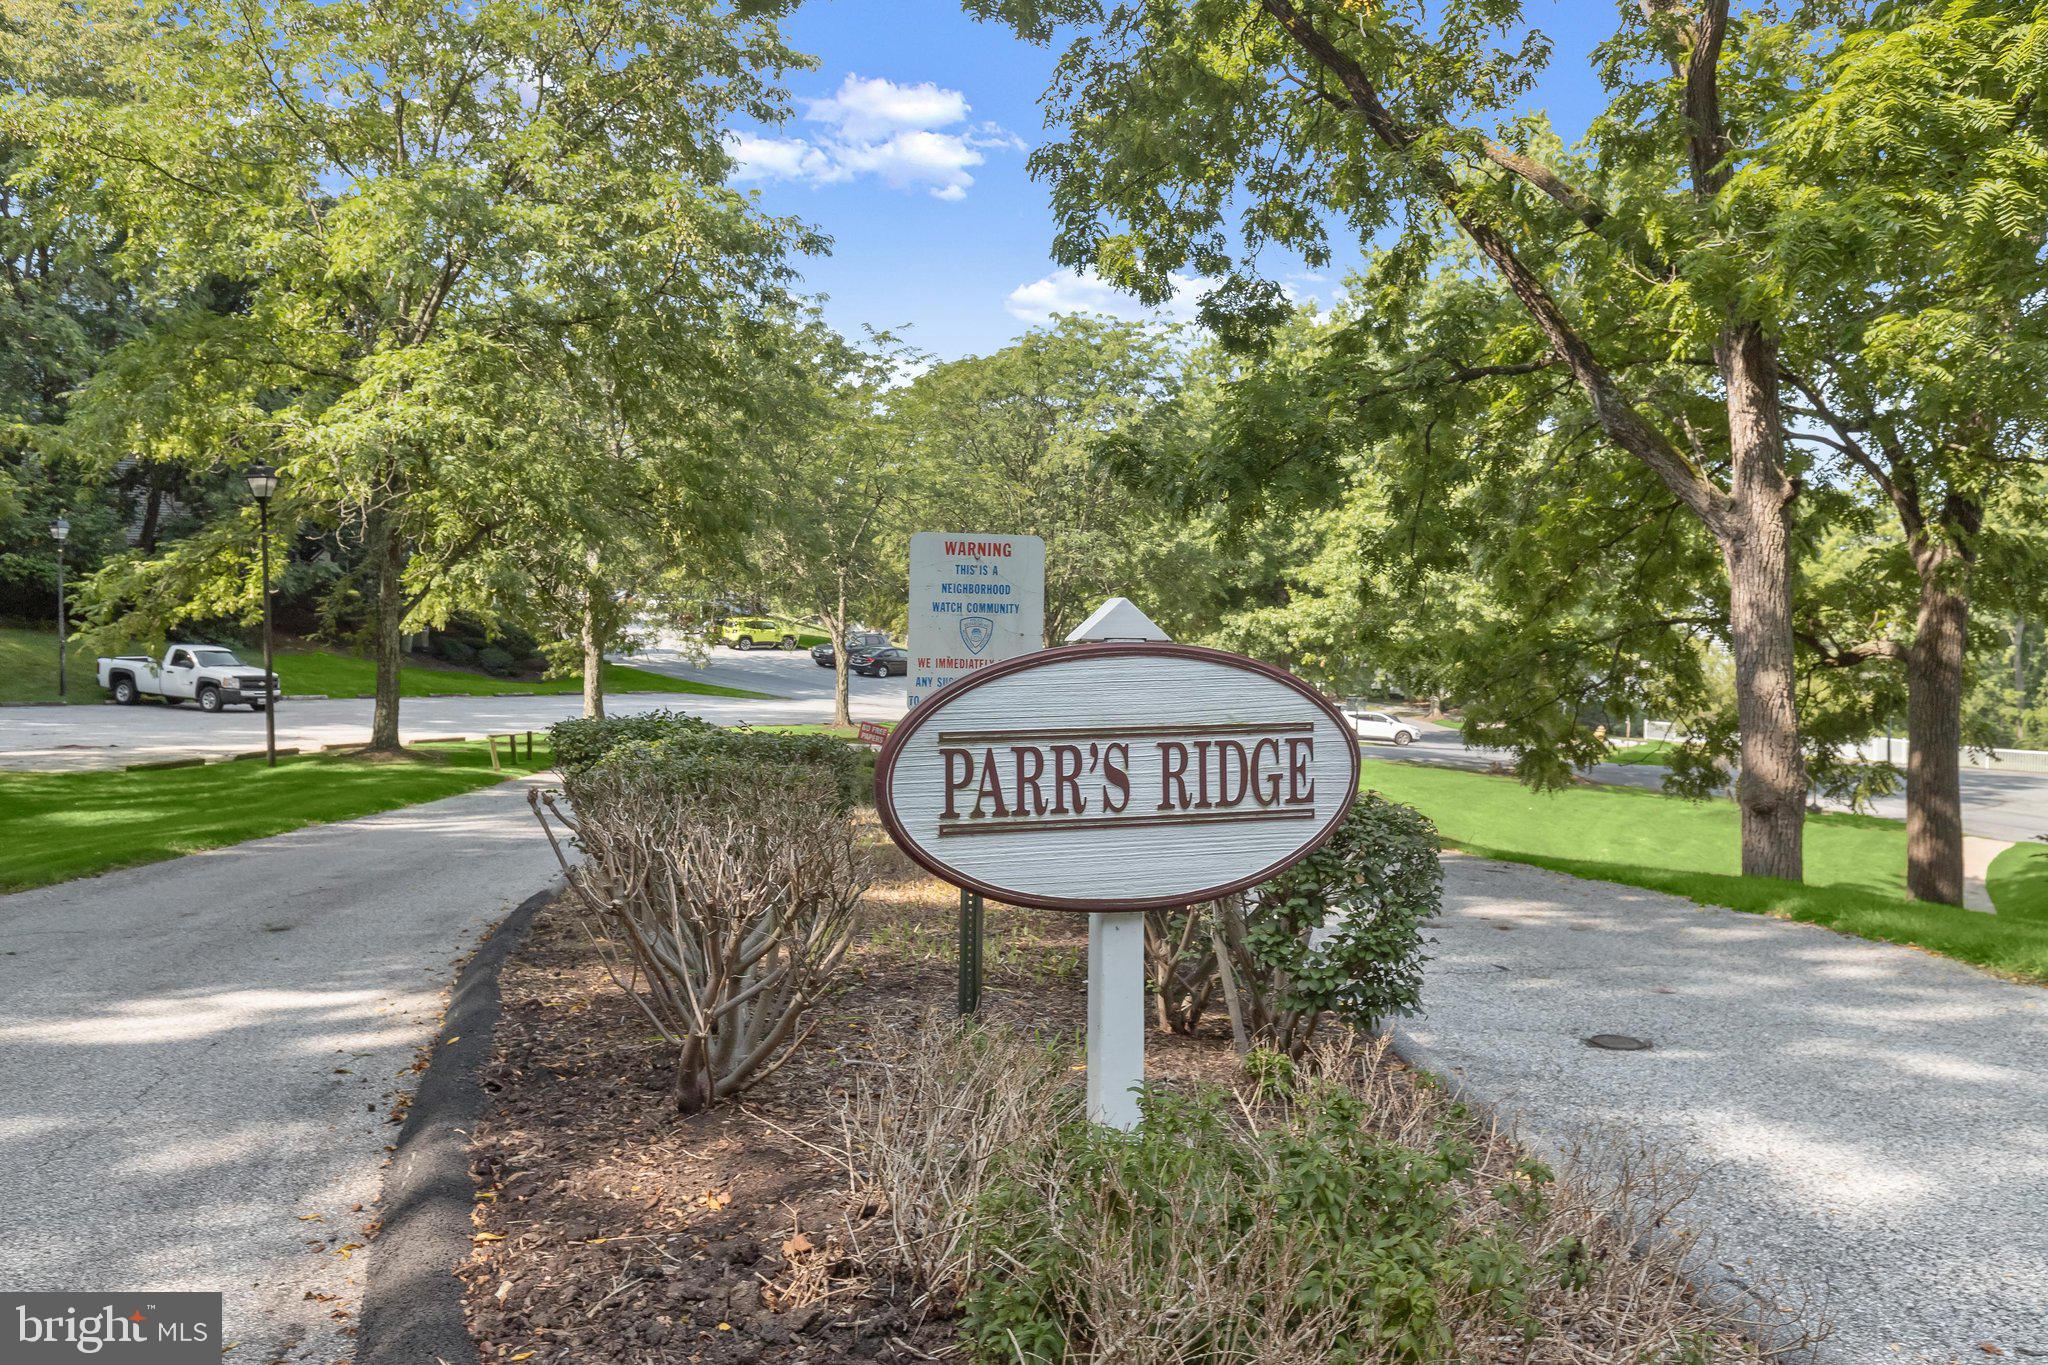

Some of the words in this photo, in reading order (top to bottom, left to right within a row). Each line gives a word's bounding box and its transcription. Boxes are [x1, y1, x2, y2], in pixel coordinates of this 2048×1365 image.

[945, 541, 1012, 558] WARNING
[955, 564, 976, 575] THIS
[979, 565, 988, 576] IS
[992, 565, 999, 576] A
[941, 583, 1011, 595] NEIGHBORHOOD
[932, 602, 962, 613] WATCH
[966, 602, 1020, 614] COMMUNITY
[917, 657, 931, 668] WE
[915, 676, 933, 687] ANY
[908, 695, 919, 706] TO
[939, 742, 1131, 820] PARR'S
[1156, 737, 1315, 811] RIDGE
